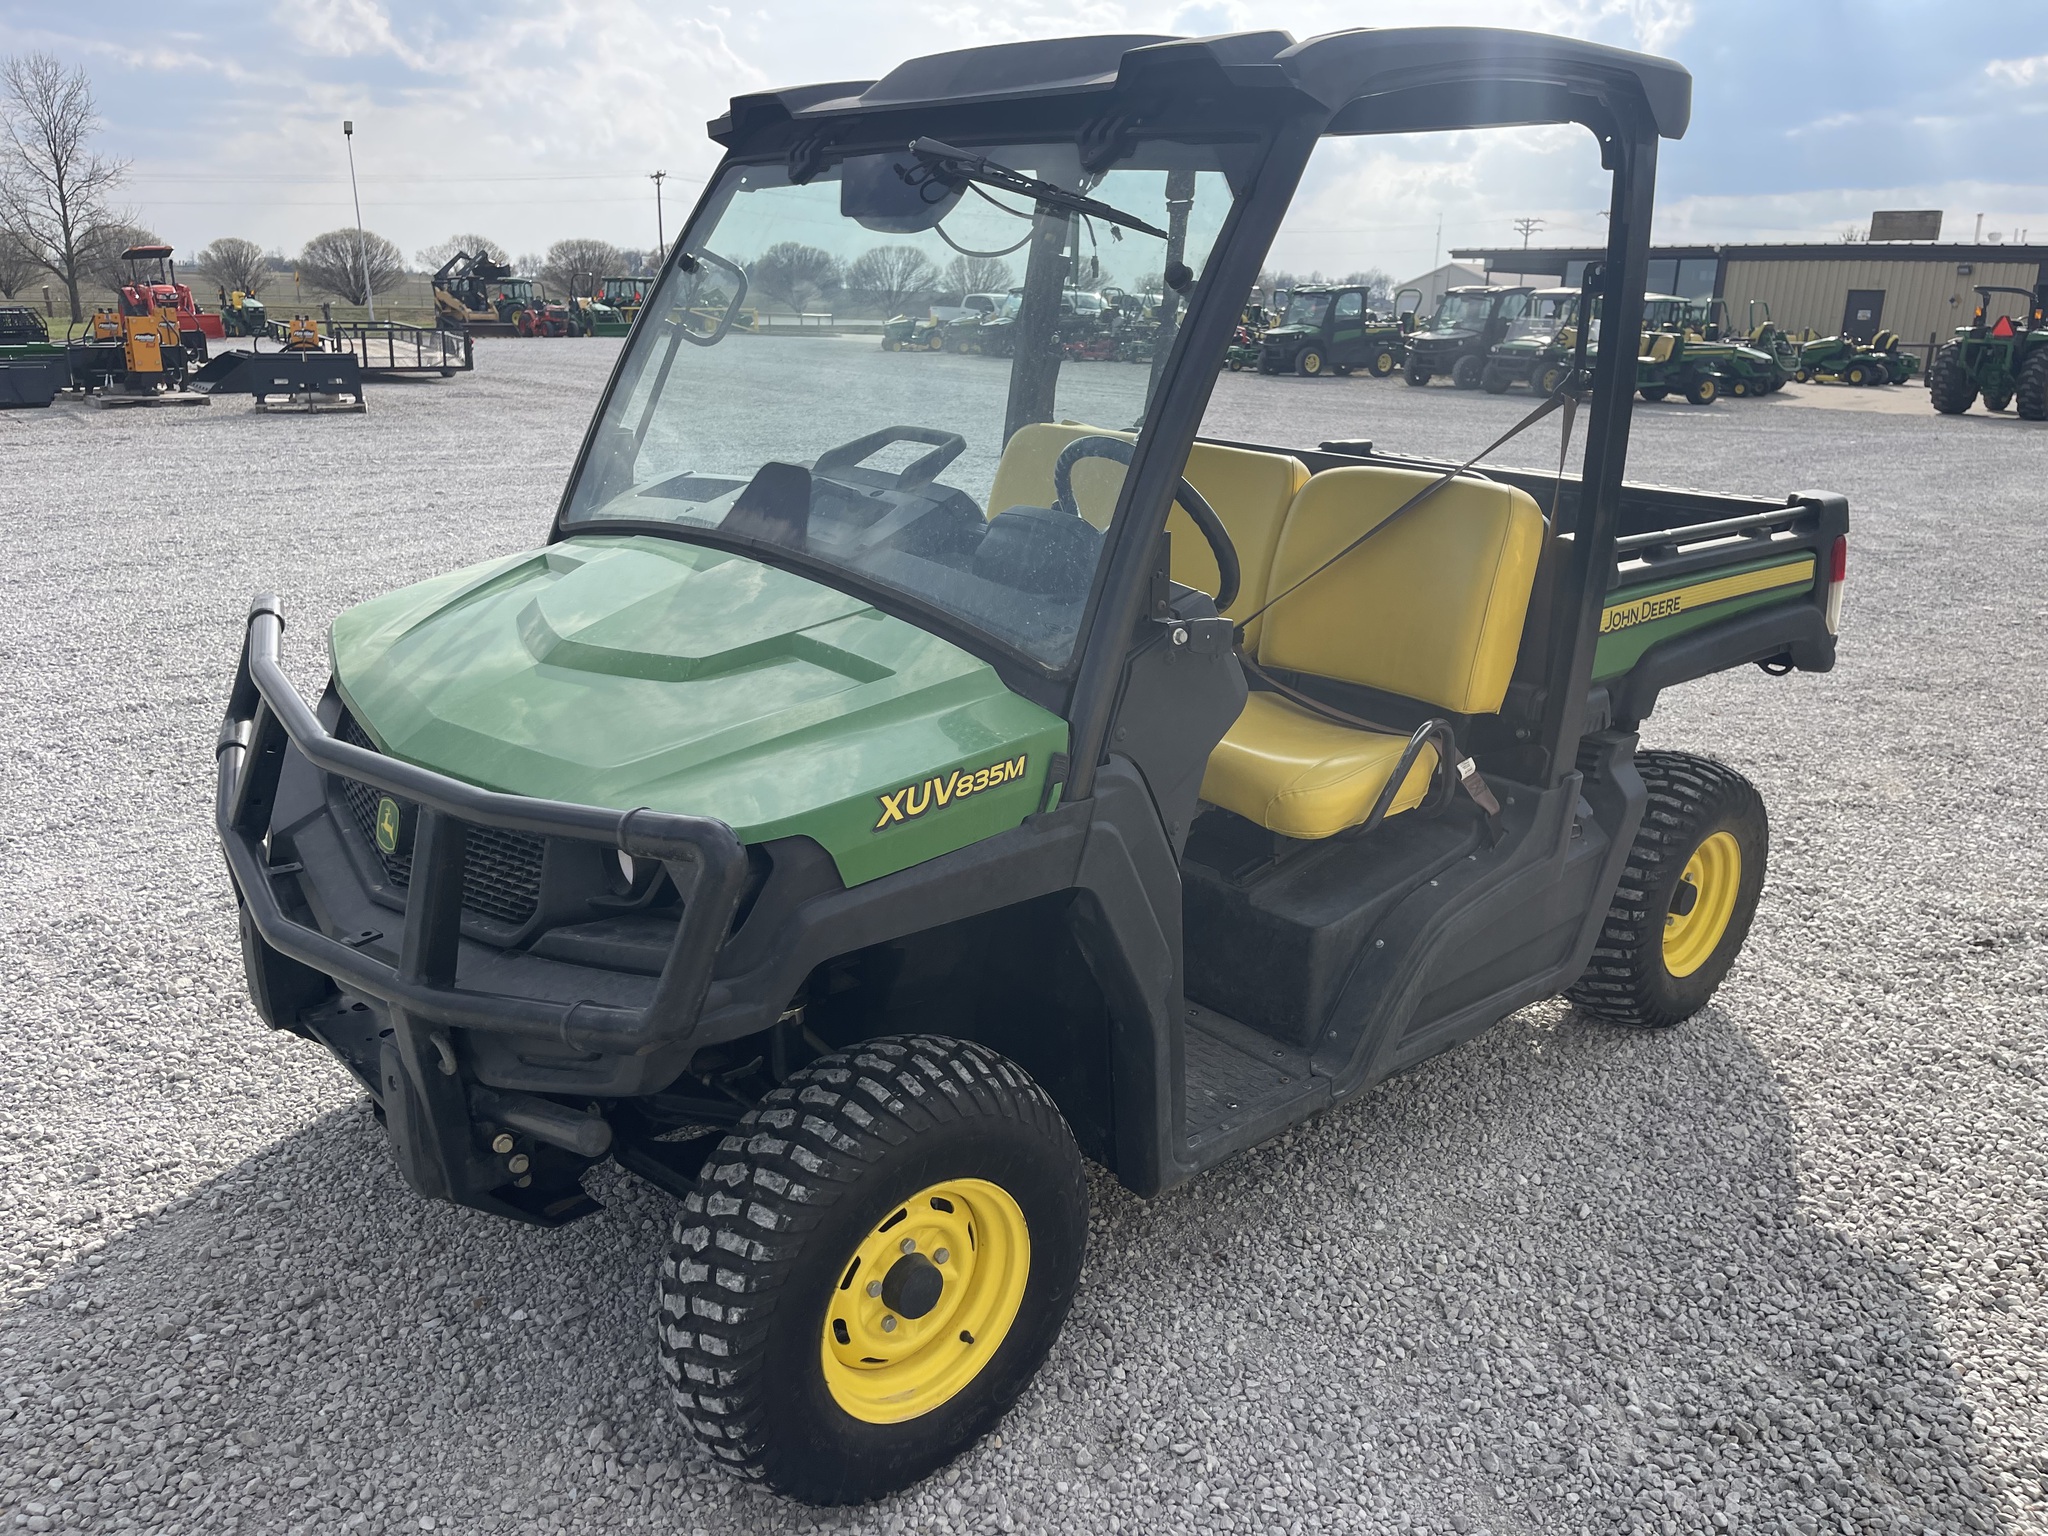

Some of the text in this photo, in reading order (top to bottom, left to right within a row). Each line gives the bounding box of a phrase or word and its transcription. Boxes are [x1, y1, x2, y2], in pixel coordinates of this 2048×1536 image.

[1605, 596, 1682, 631] JOHN DEERE
[875, 755, 1026, 829] XUV835M
